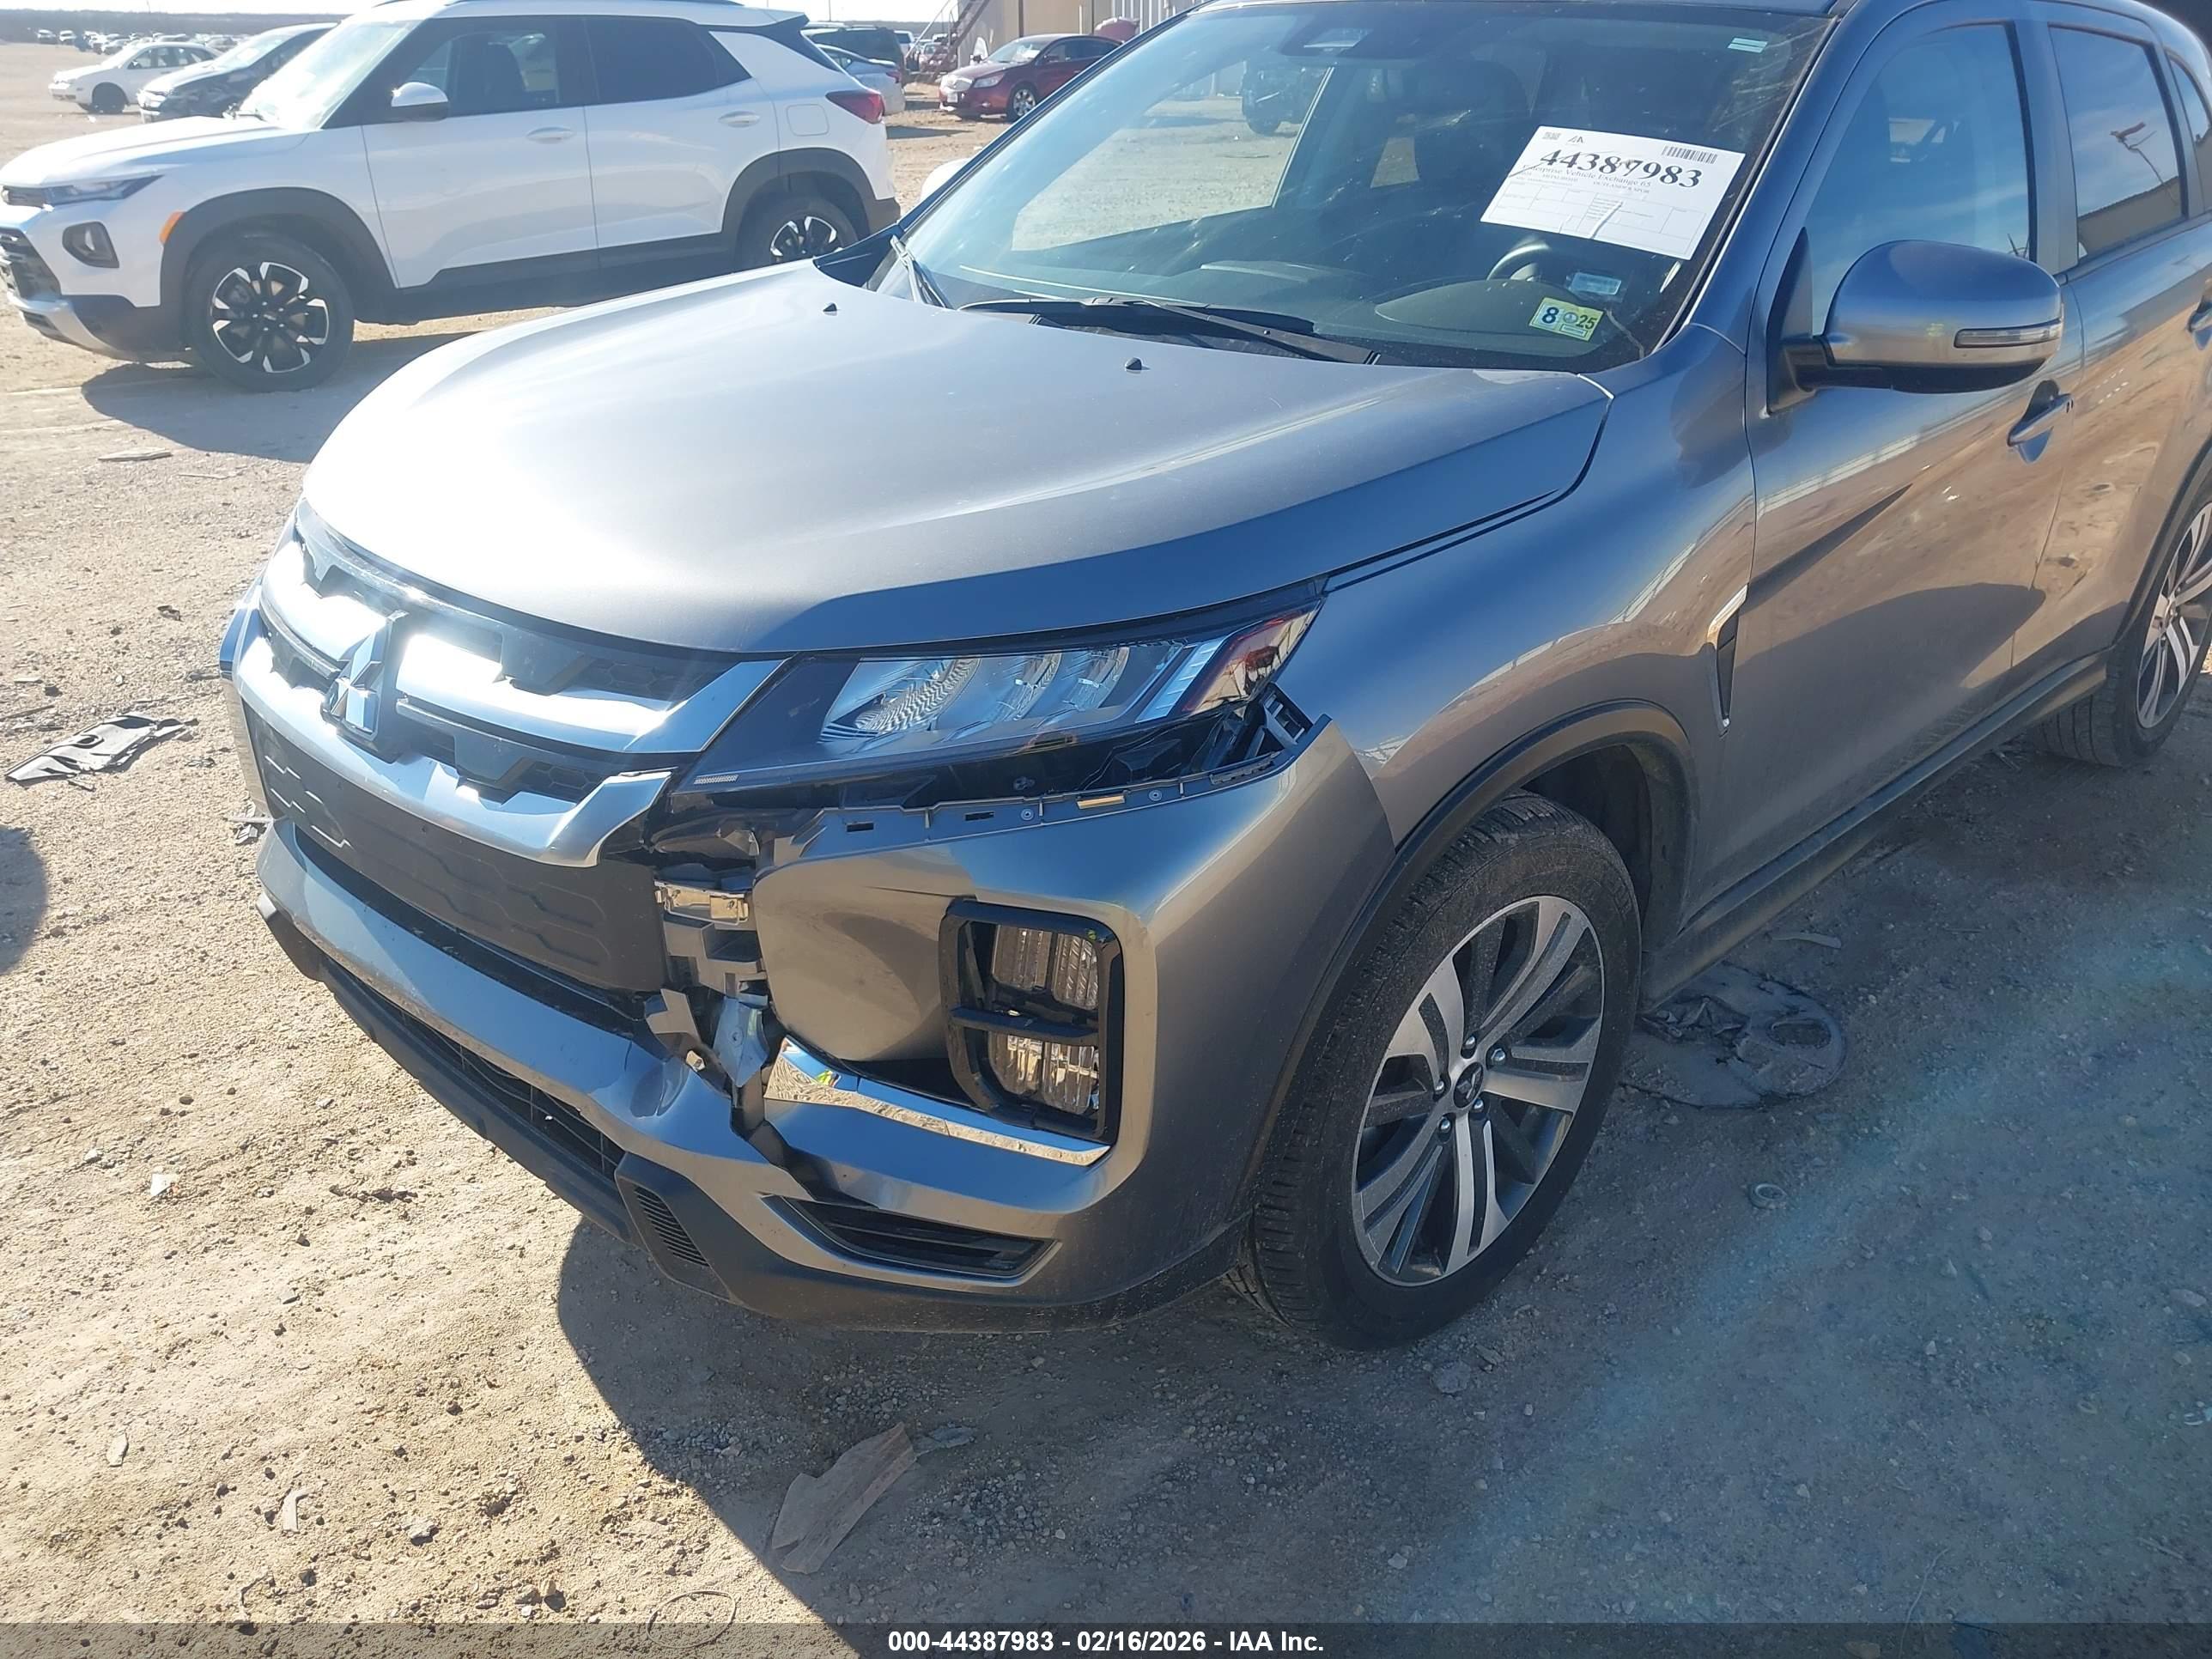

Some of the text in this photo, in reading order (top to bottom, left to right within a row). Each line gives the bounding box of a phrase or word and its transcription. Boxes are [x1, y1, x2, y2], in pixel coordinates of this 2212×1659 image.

[1540, 149, 1702, 188] 44387983
[1566, 168, 1596, 179] Vehicle
[1598, 174, 1638, 186] Exchange
[1541, 307, 1598, 330] 8 25
